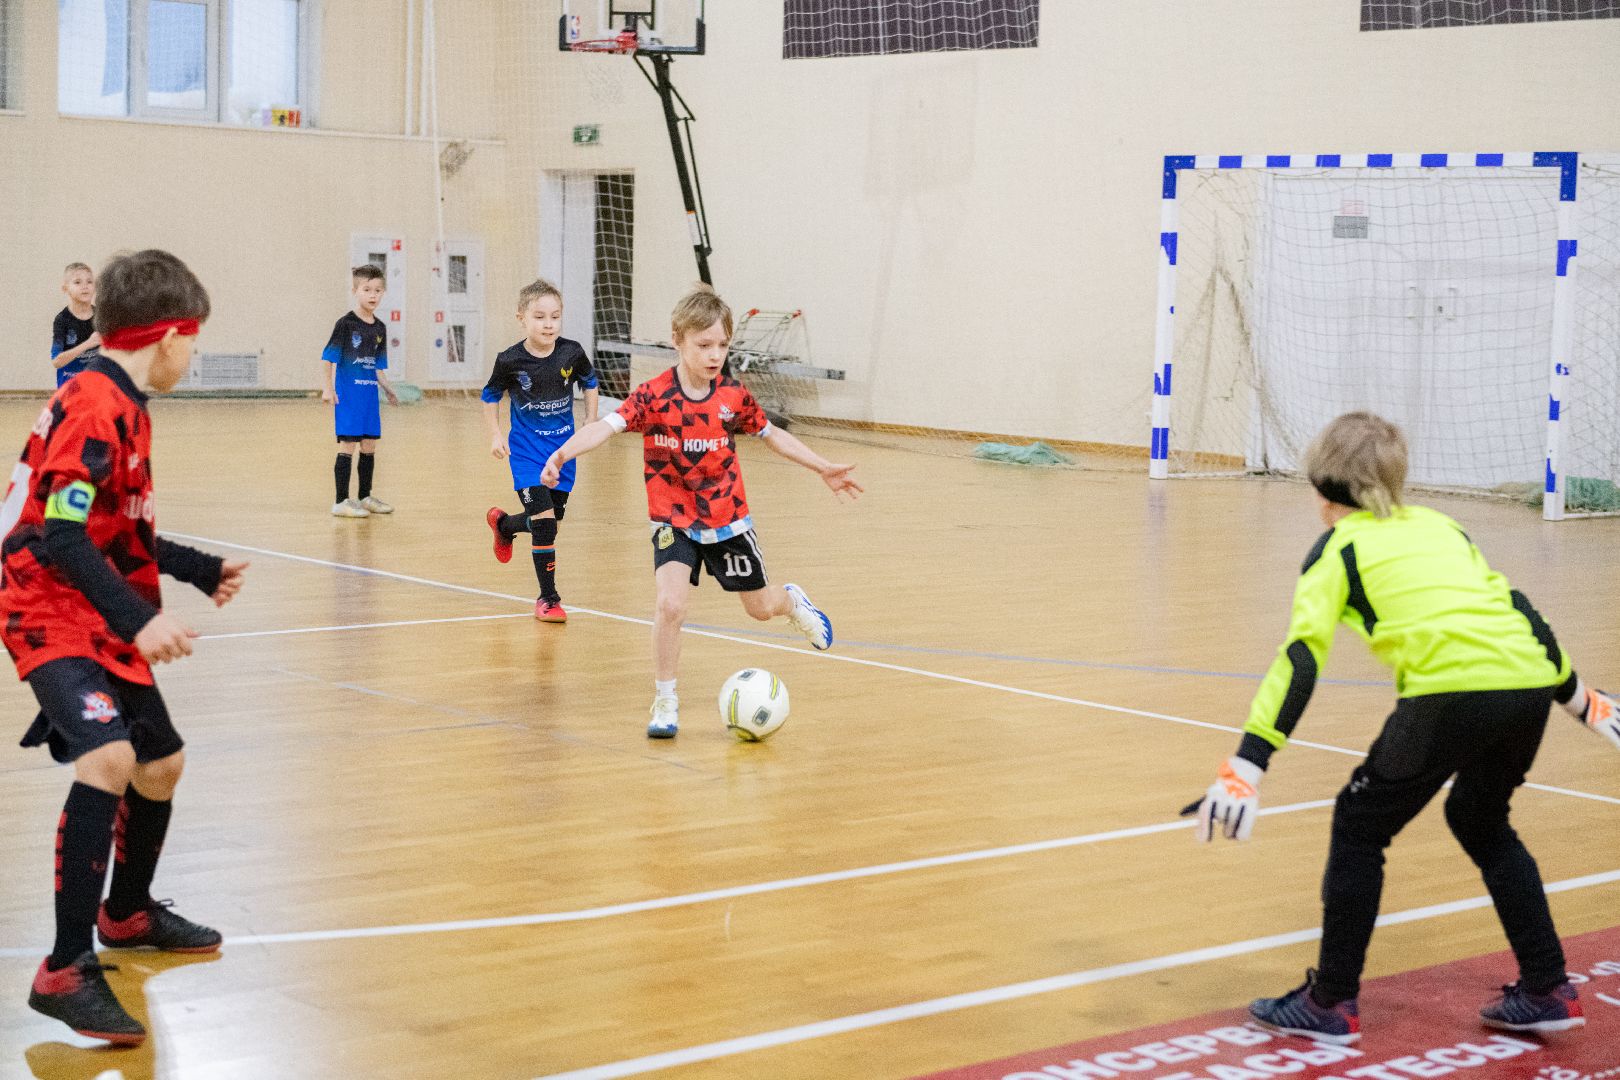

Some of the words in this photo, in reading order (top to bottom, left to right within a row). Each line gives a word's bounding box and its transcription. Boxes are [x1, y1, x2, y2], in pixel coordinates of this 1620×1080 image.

[654, 433, 679, 450] ШФ
[67, 489, 91, 510] C
[723, 552, 753, 577] 10
[1153, 1041, 1365, 1080] АСЫ
[1317, 1035, 1542, 1080] ТЕСЫ
